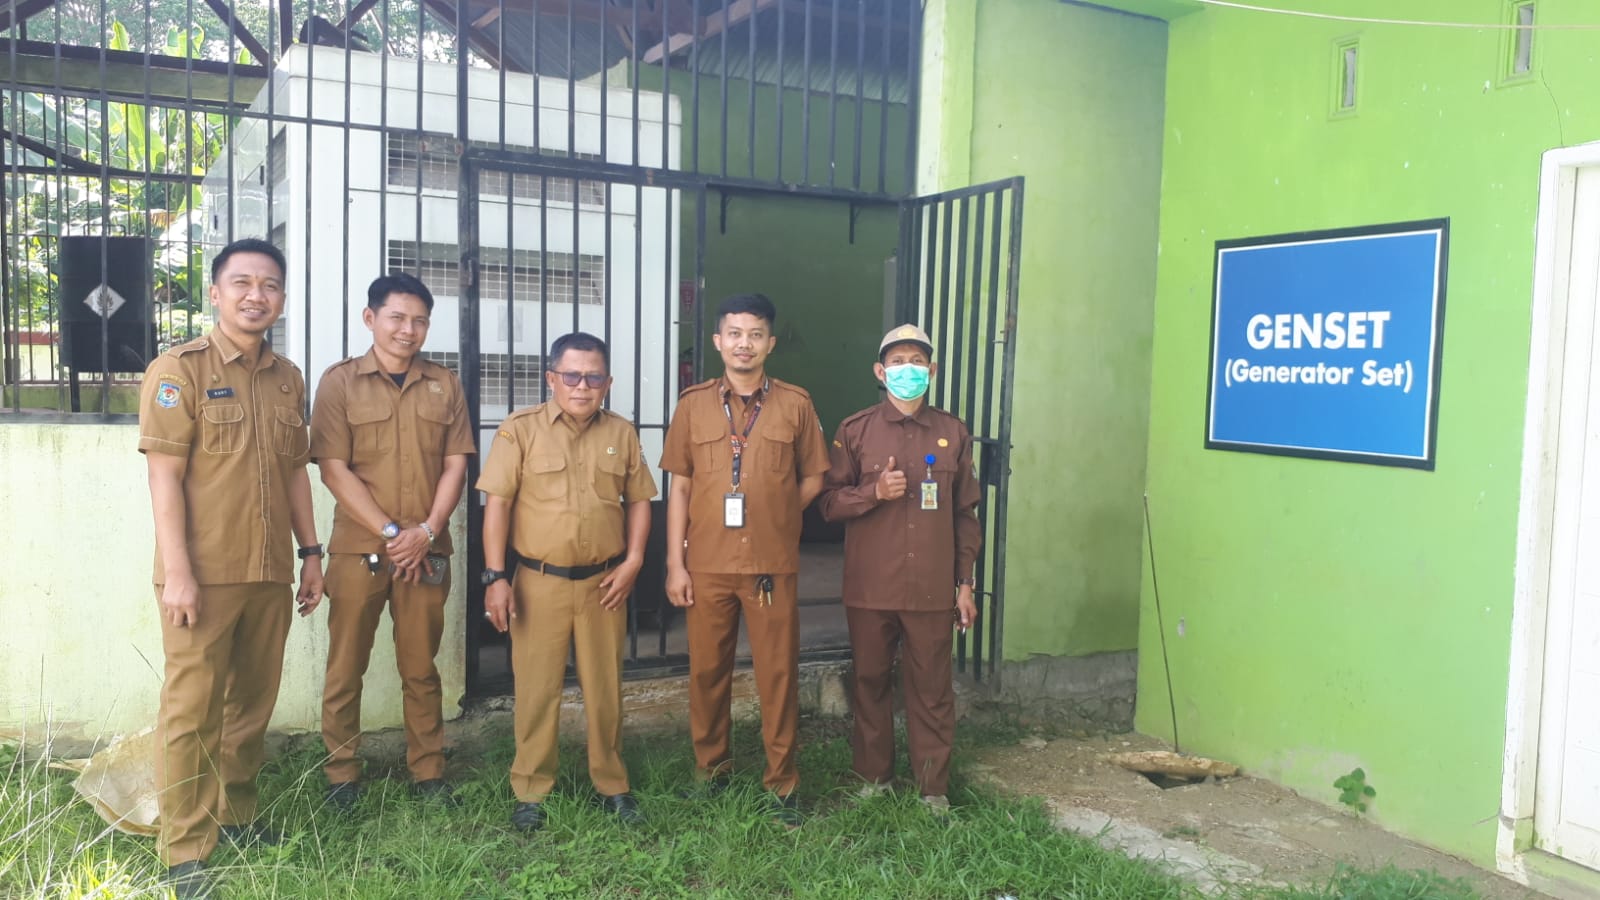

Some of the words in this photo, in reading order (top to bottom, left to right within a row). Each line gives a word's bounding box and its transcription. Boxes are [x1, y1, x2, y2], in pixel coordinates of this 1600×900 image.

[1246, 311, 1391, 350] GENSET
[1224, 358, 1354, 388] (Generator
[1361, 359, 1414, 394] Set)
